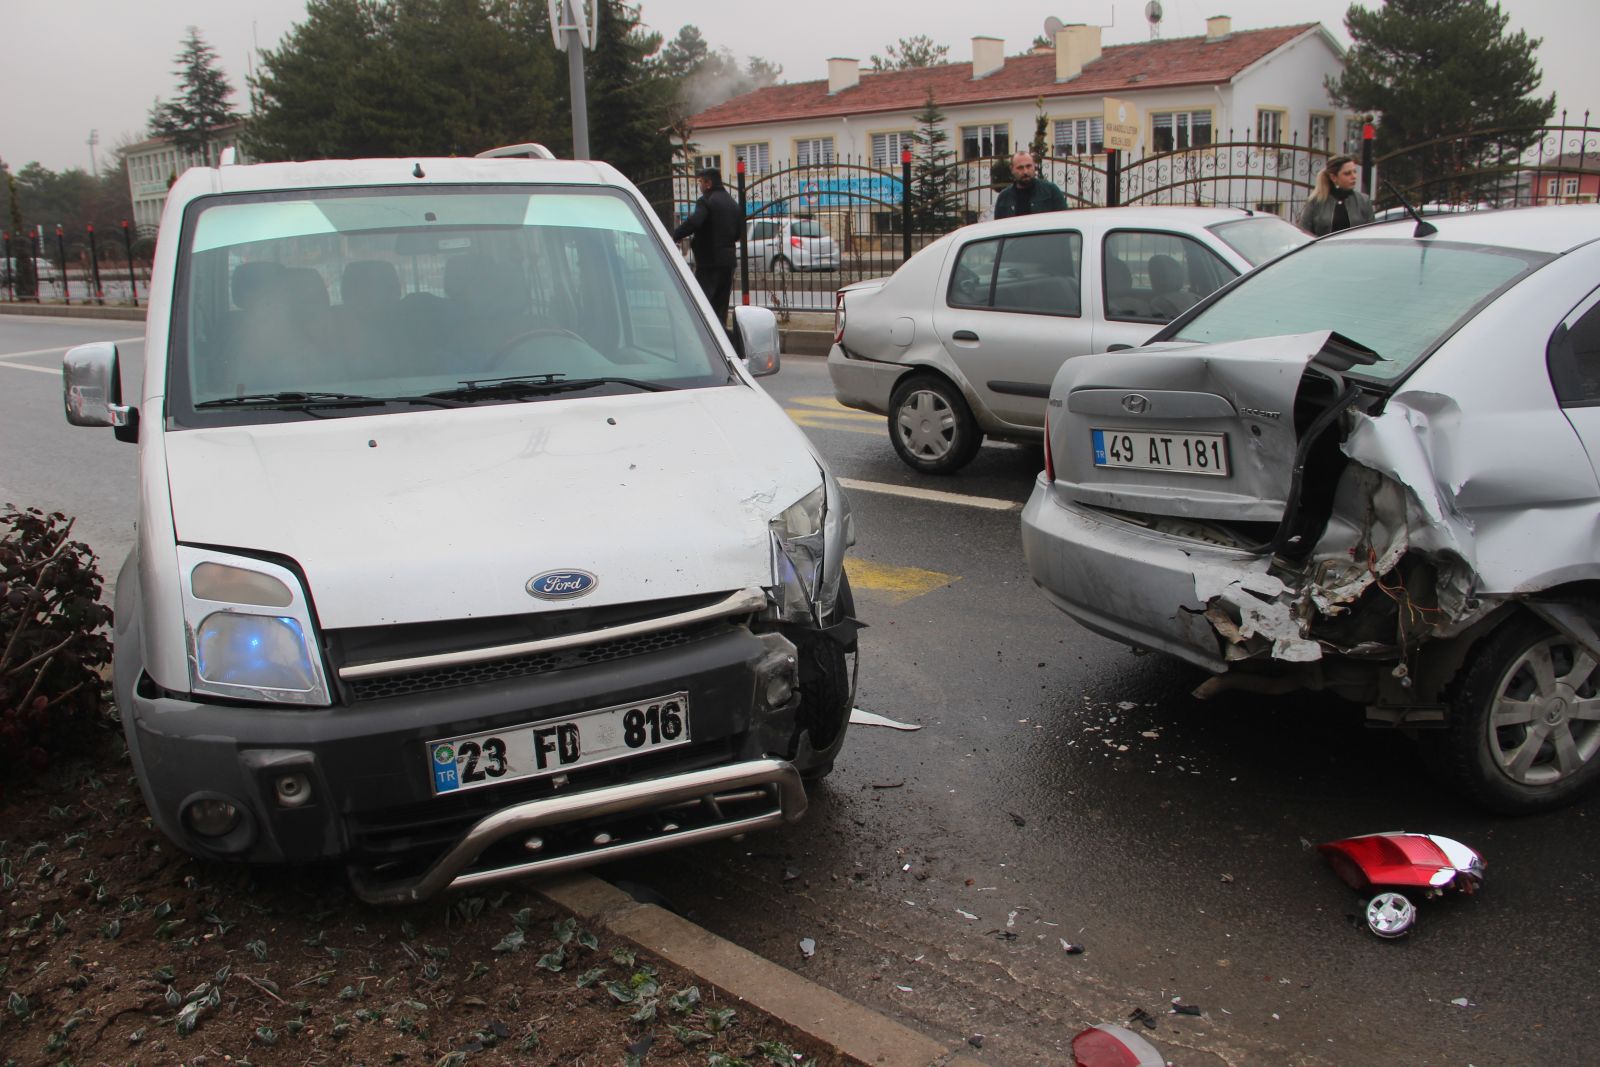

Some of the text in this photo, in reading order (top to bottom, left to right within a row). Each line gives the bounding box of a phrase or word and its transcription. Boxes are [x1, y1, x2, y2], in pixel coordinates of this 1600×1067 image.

[1096, 435, 1220, 469] TR 49 AT 181
[543, 575, 582, 592] Ford
[438, 701, 682, 783] TR 23 FD 816
